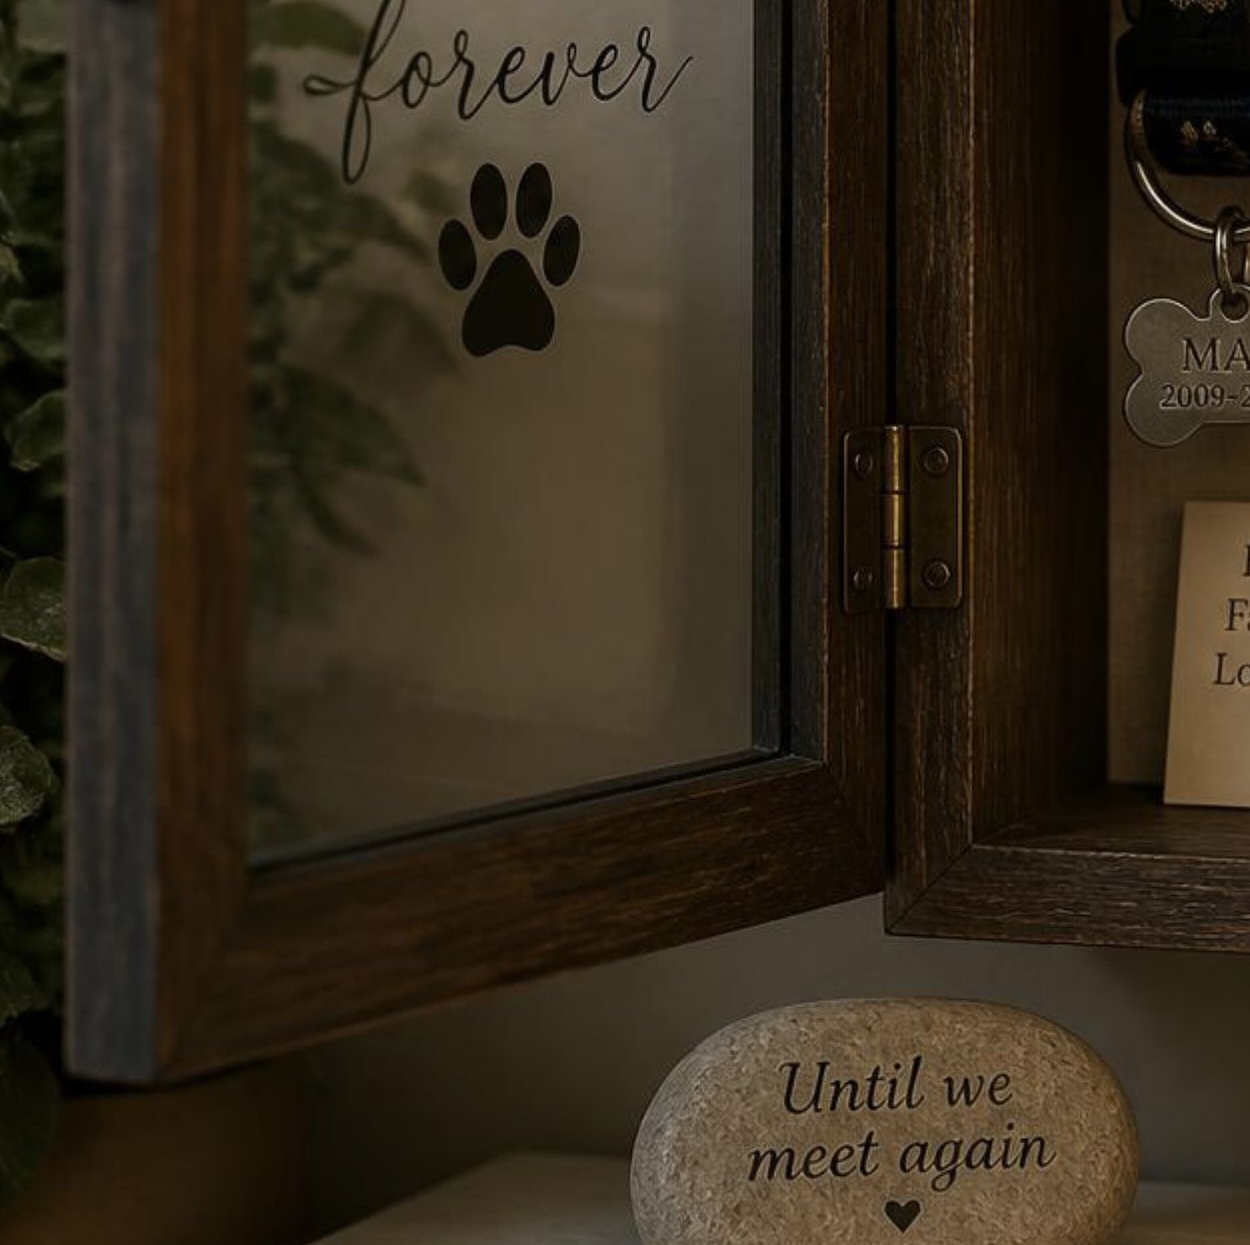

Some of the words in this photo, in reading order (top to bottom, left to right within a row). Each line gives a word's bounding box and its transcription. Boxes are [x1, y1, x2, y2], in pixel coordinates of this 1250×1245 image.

[778, 1055, 924, 1114] Until
[943, 1072, 1014, 1107] we
[747, 1130, 881, 1182] meet
[898, 1123, 1057, 1192] again
